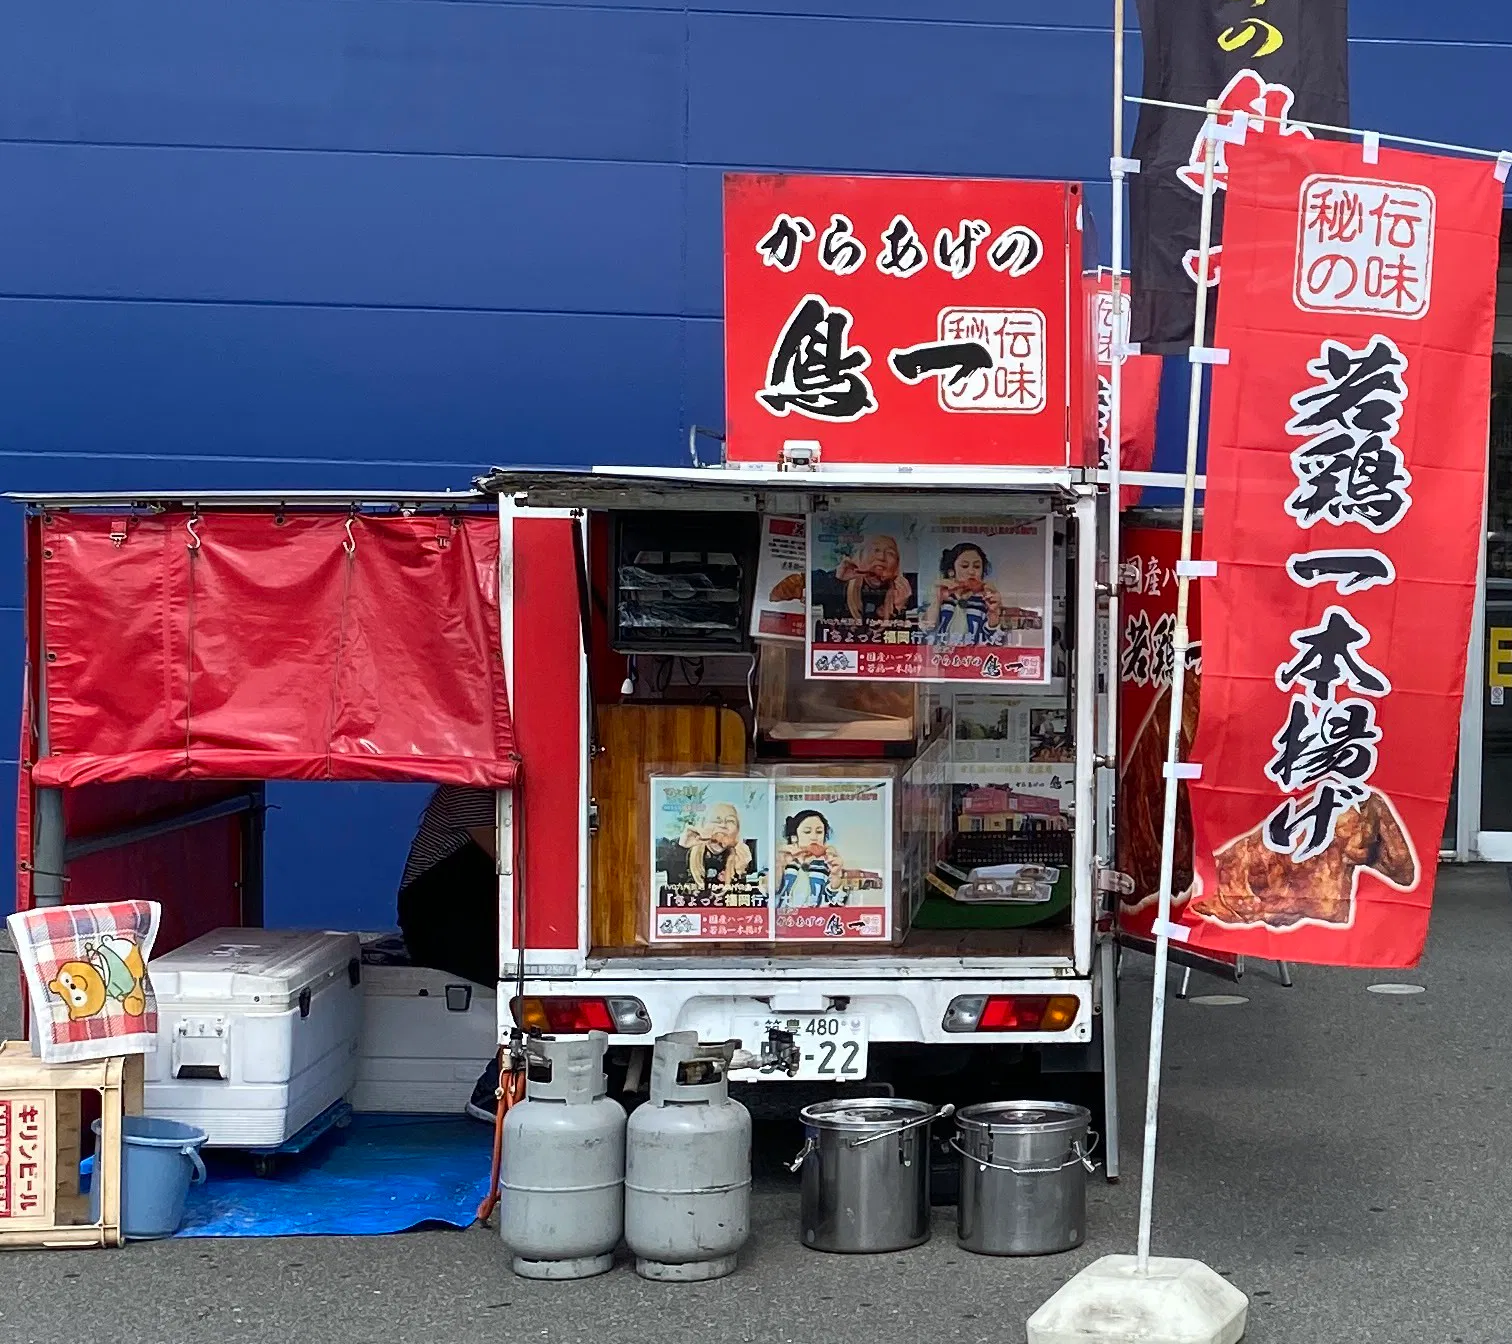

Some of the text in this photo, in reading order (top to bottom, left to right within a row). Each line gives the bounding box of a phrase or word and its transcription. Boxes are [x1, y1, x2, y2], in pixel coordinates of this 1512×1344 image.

[755, 213, 1043, 278] からあげの
[1307, 189, 1424, 249] 秘伝
[1306, 253, 1420, 309] の味
[1262, 333, 1413, 864] 若鶏一本揚げ
[805, 1018, 839, 1036] 480
[18, 1104, 39, 1212] キリンビール
